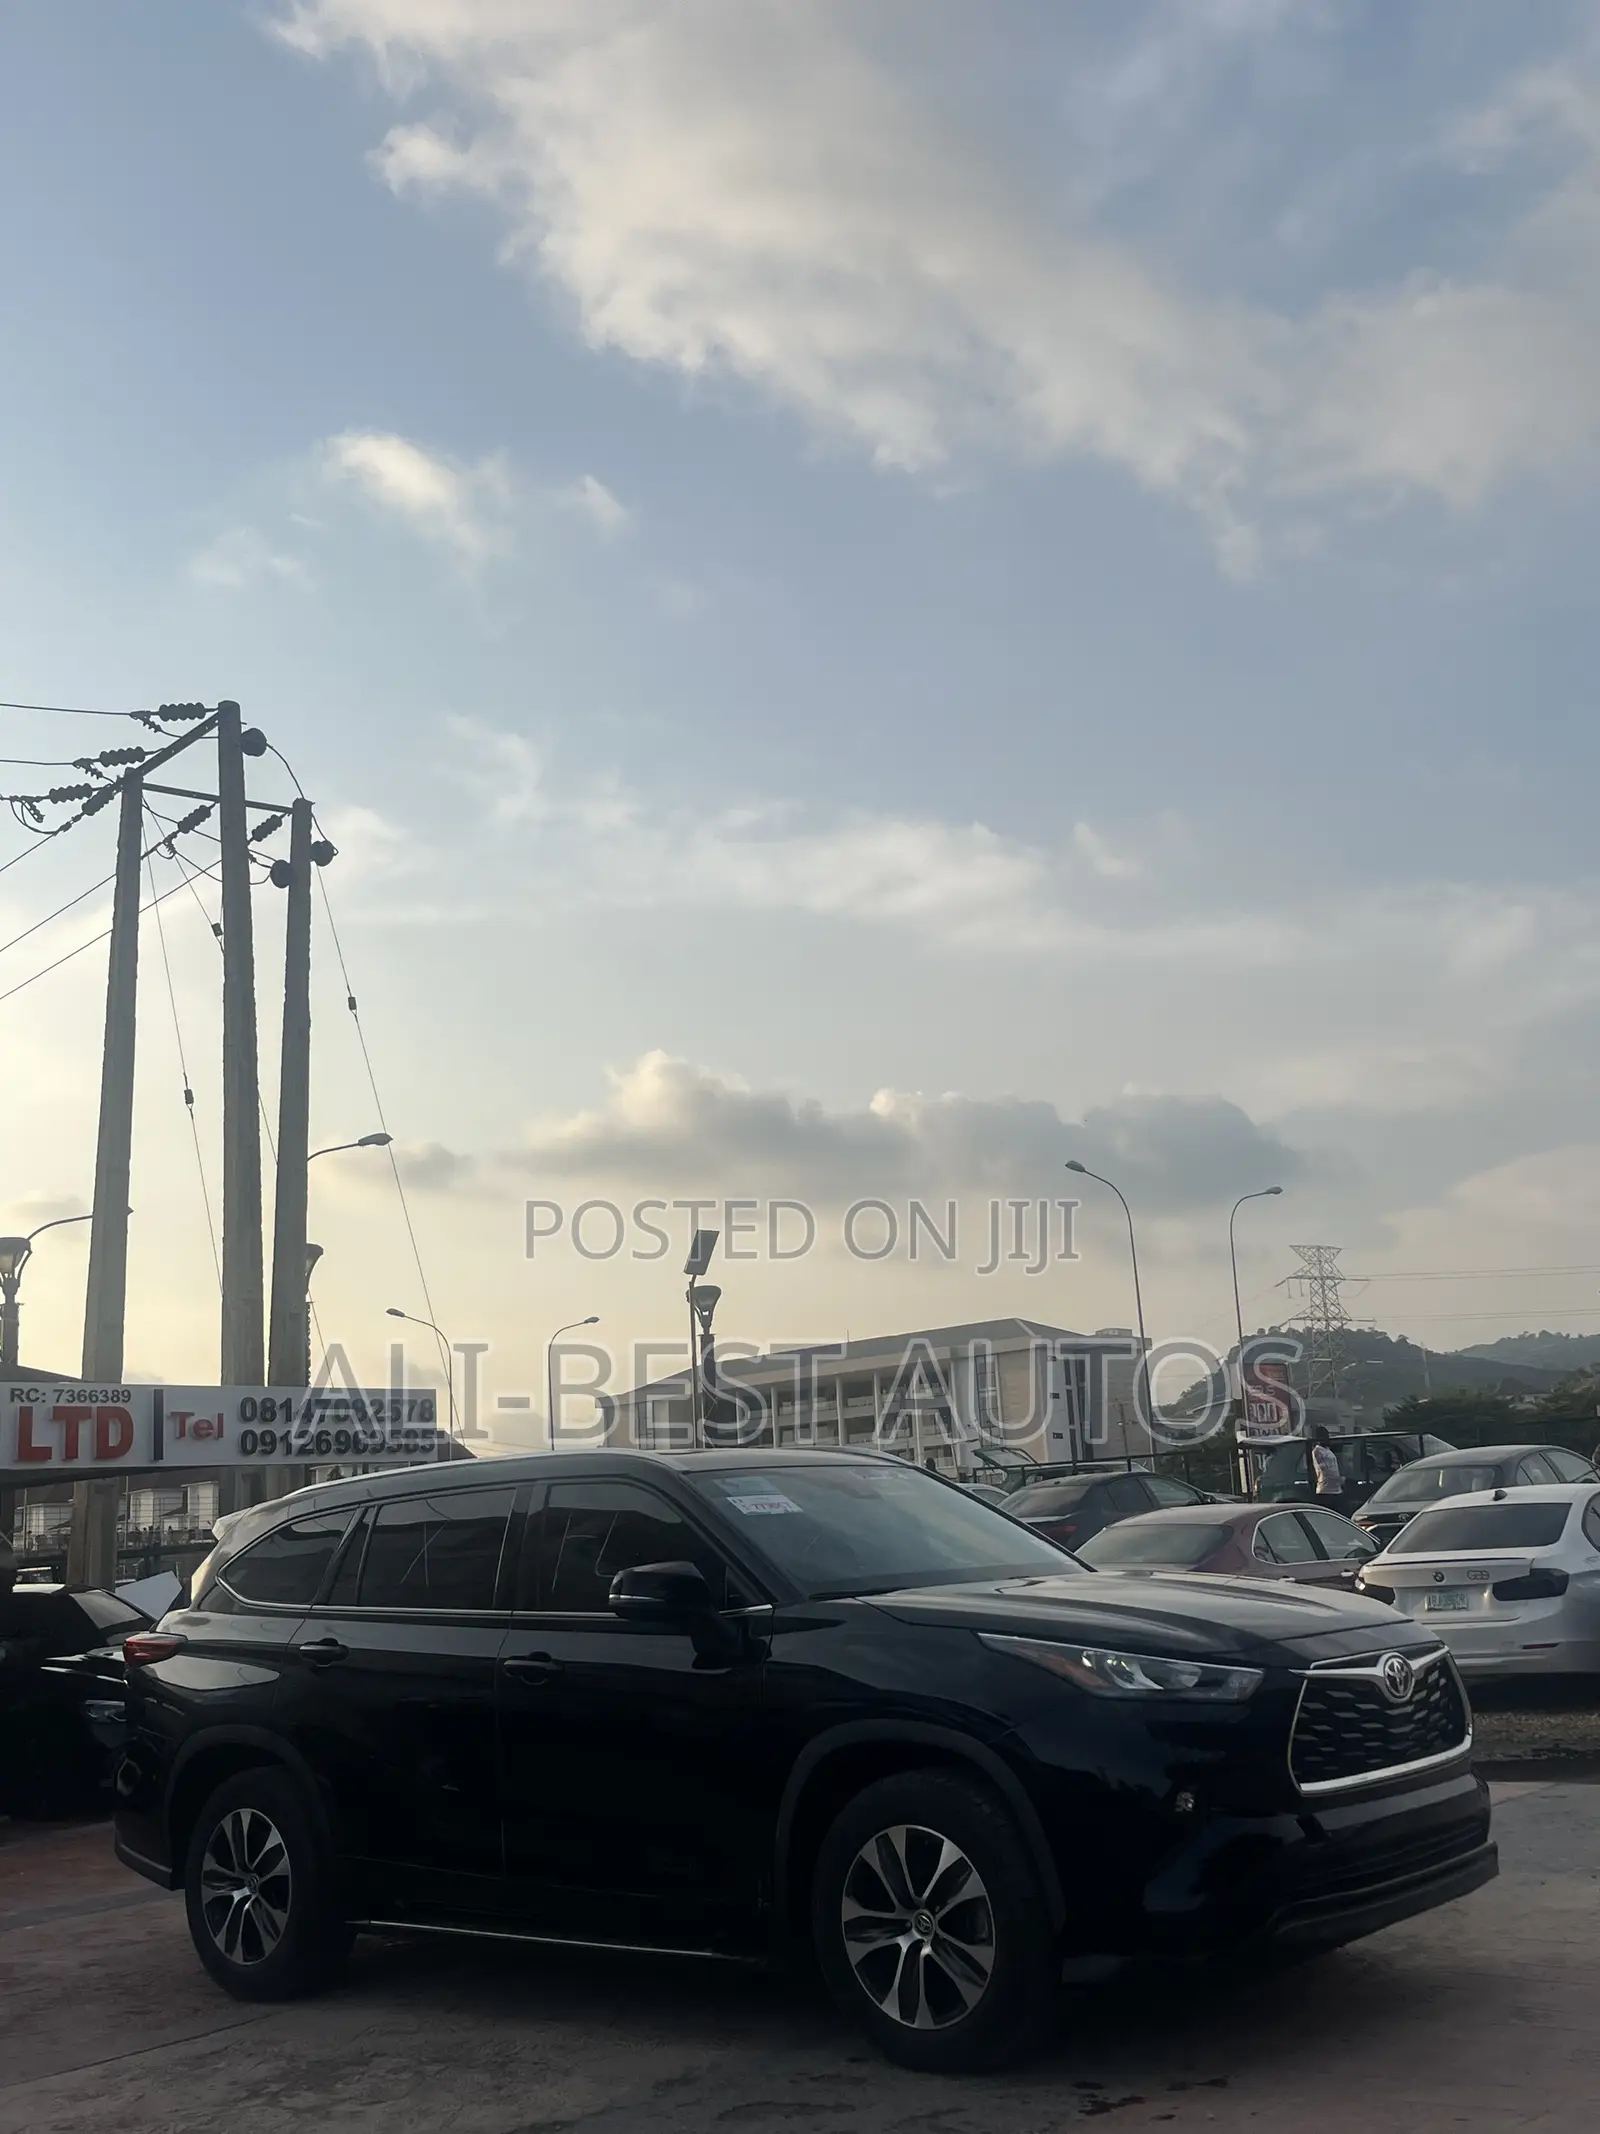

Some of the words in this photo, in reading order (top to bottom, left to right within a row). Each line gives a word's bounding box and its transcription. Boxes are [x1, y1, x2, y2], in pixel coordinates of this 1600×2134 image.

[10, 1387, 46, 1403] RC:
[53, 1388, 132, 1404] 7366389
[17, 1405, 134, 1461] LTD
[170, 1411, 224, 1440] Tel
